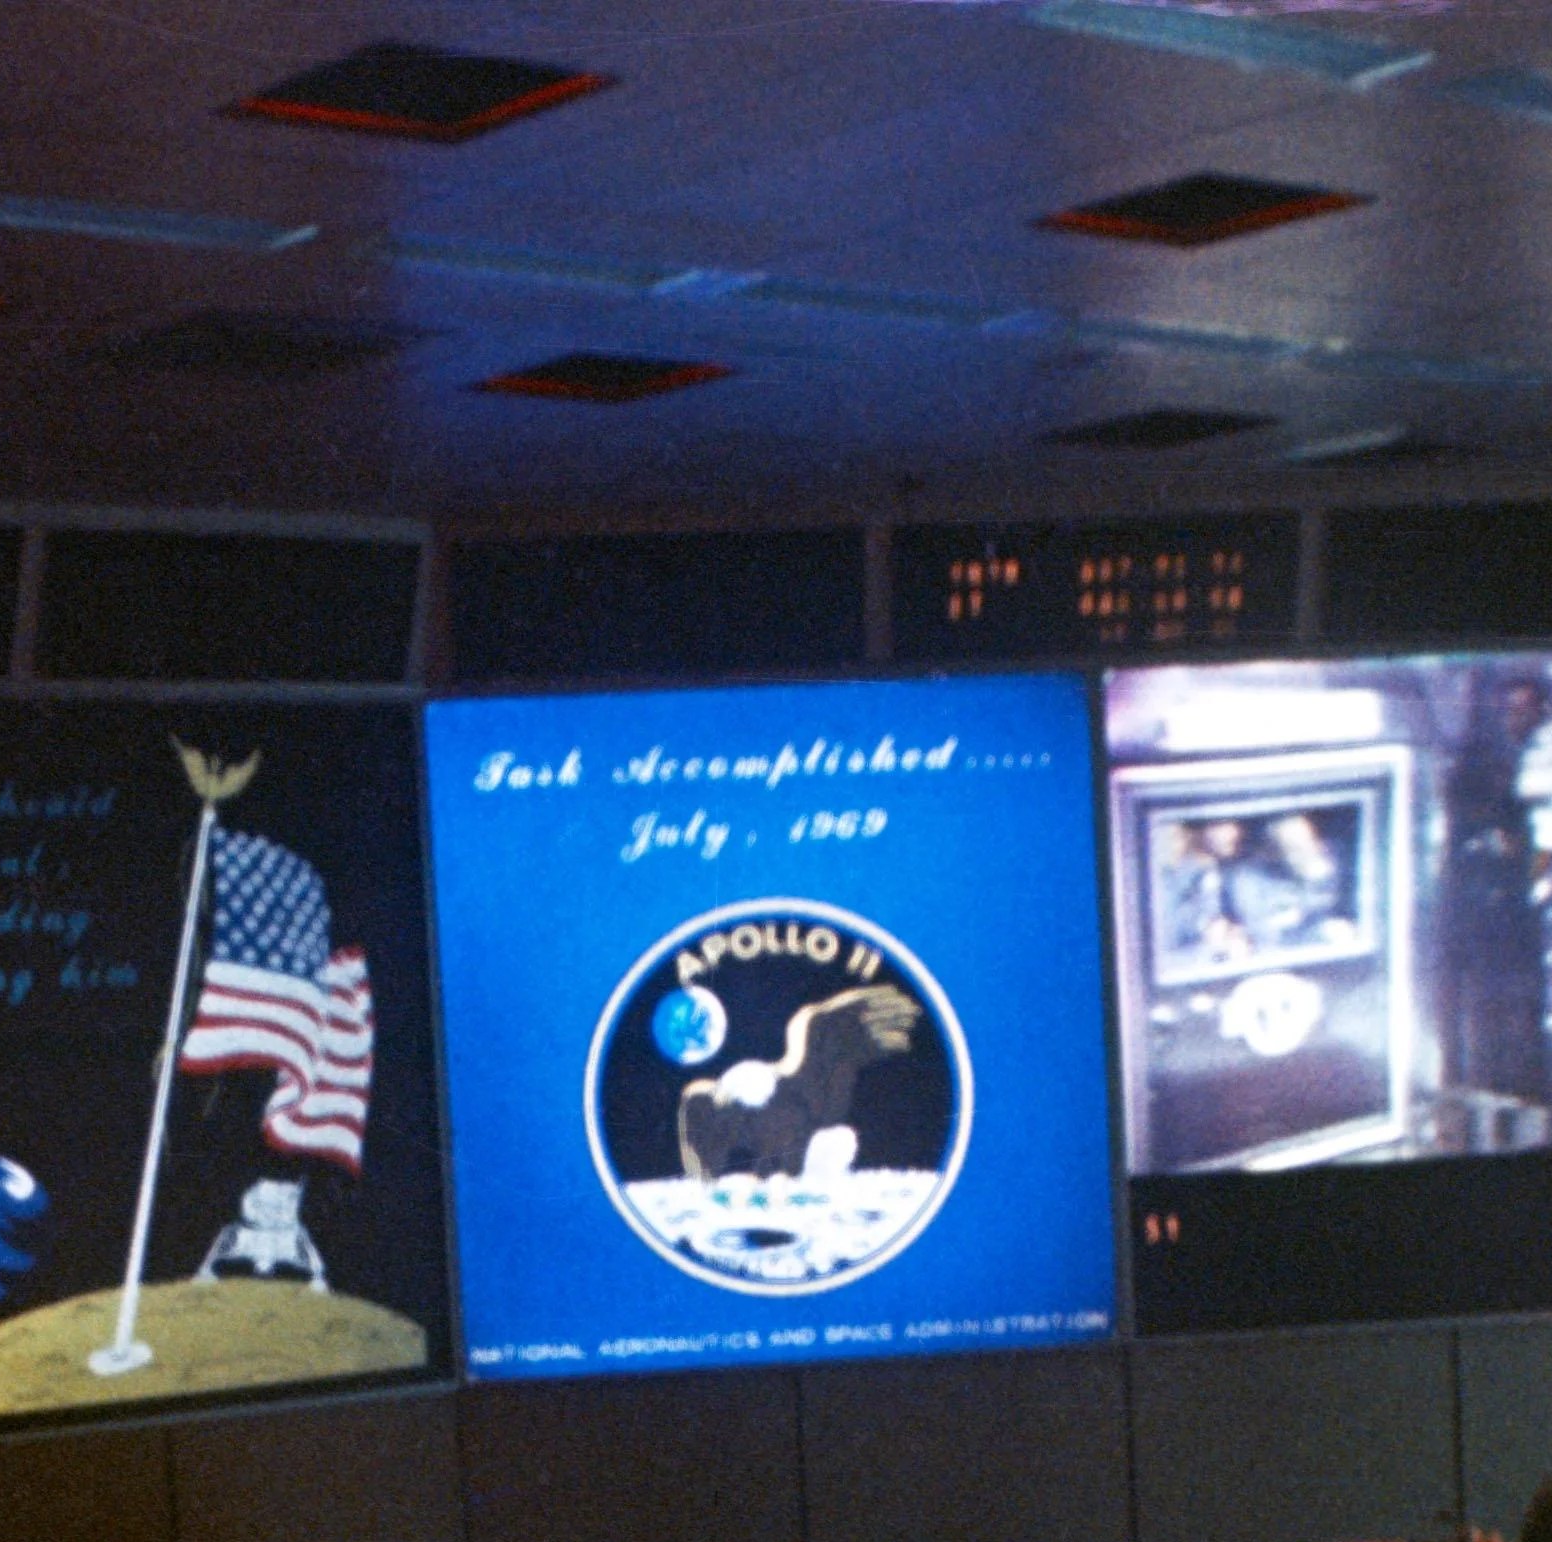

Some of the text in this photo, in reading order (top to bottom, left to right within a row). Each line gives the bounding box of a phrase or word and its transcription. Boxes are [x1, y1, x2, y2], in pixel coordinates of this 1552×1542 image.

[789, 807, 888, 844] 1969
[674, 921, 841, 986] APOLLO
[470, 1311, 1109, 1366] NATIONAL AERONAUTICS AND SPACE ADMINISTRATION
